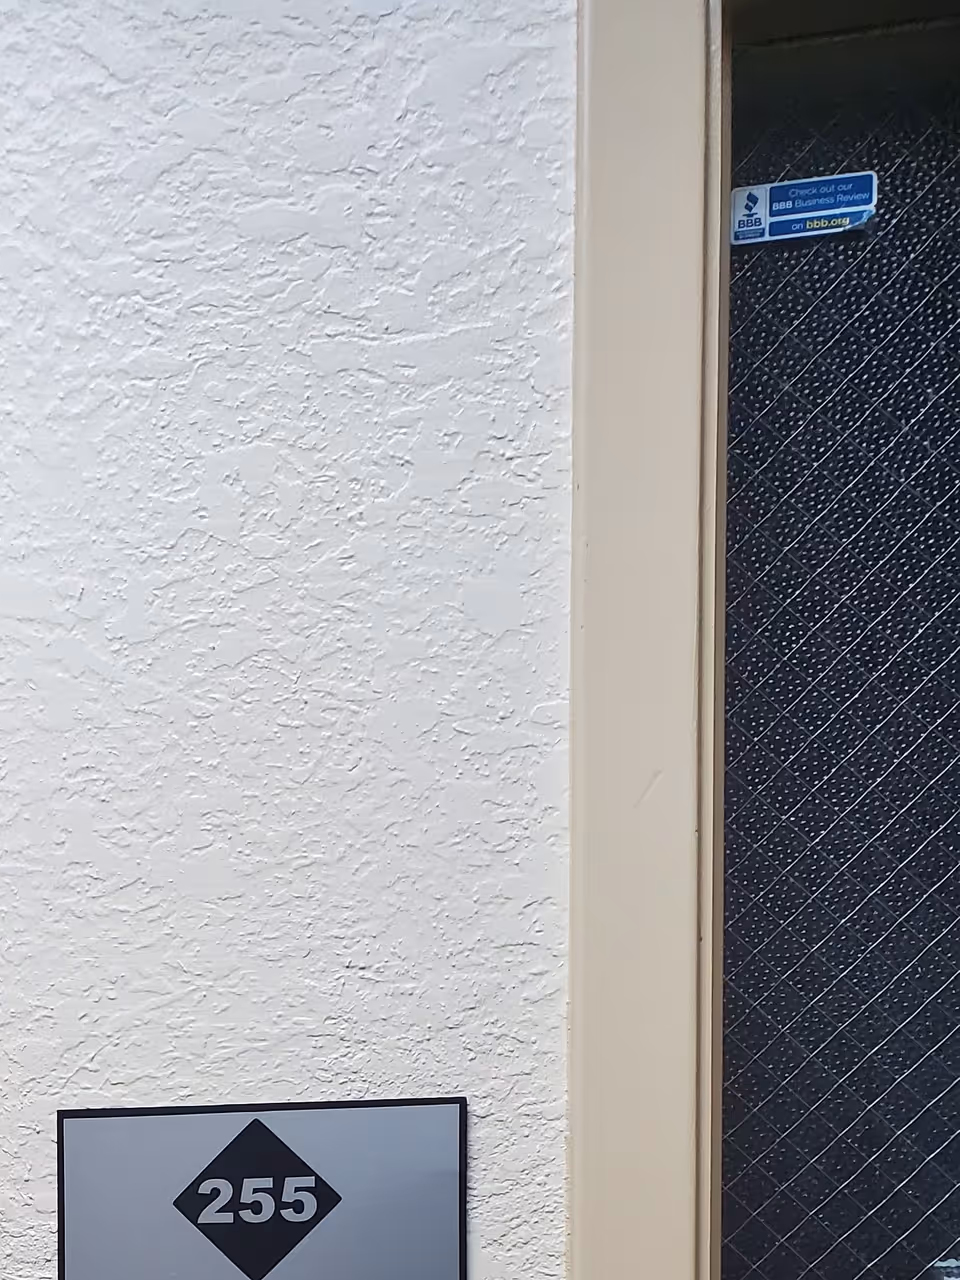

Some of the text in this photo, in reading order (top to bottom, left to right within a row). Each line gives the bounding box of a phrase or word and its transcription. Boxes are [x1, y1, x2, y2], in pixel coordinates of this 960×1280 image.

[789, 184, 853, 197] Check out our
[773, 192, 870, 210] BBB Business Review
[738, 218, 762, 229] BBB
[792, 217, 850, 231] on bbb.org
[197, 1176, 318, 1224] 255
